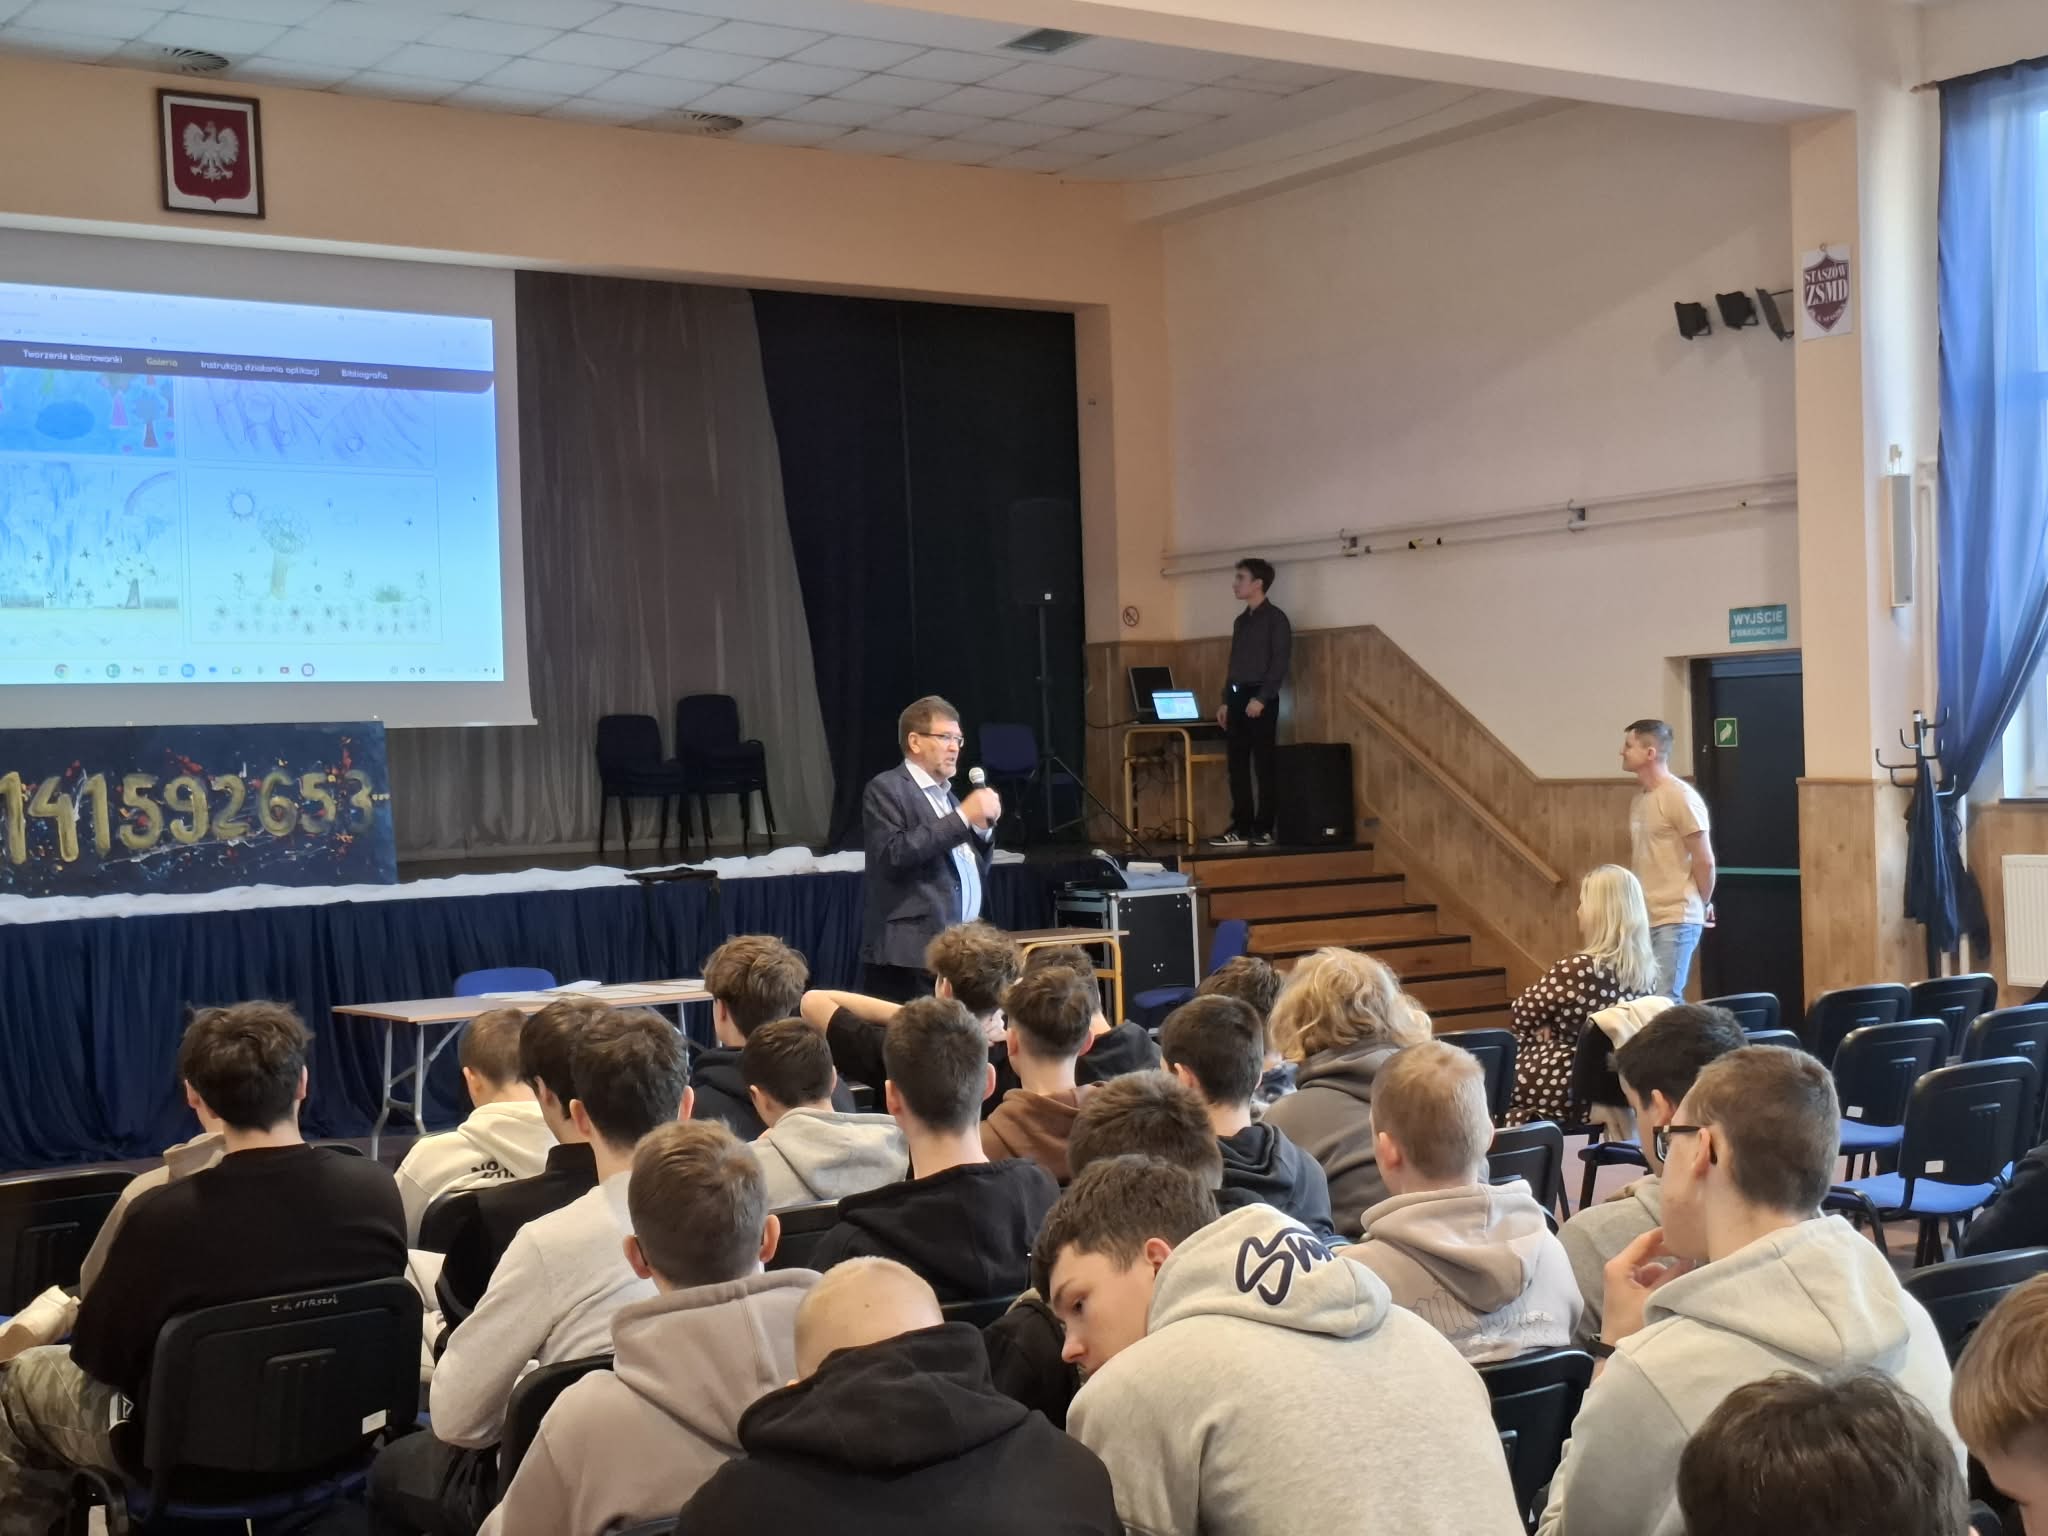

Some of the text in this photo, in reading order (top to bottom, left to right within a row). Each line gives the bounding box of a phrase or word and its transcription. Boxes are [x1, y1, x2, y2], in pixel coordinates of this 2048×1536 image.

[1805, 265, 1846, 283] STASZÓW
[1806, 280, 1848, 307] ZSMD
[1732, 610, 1784, 625] WYJŚCIE
